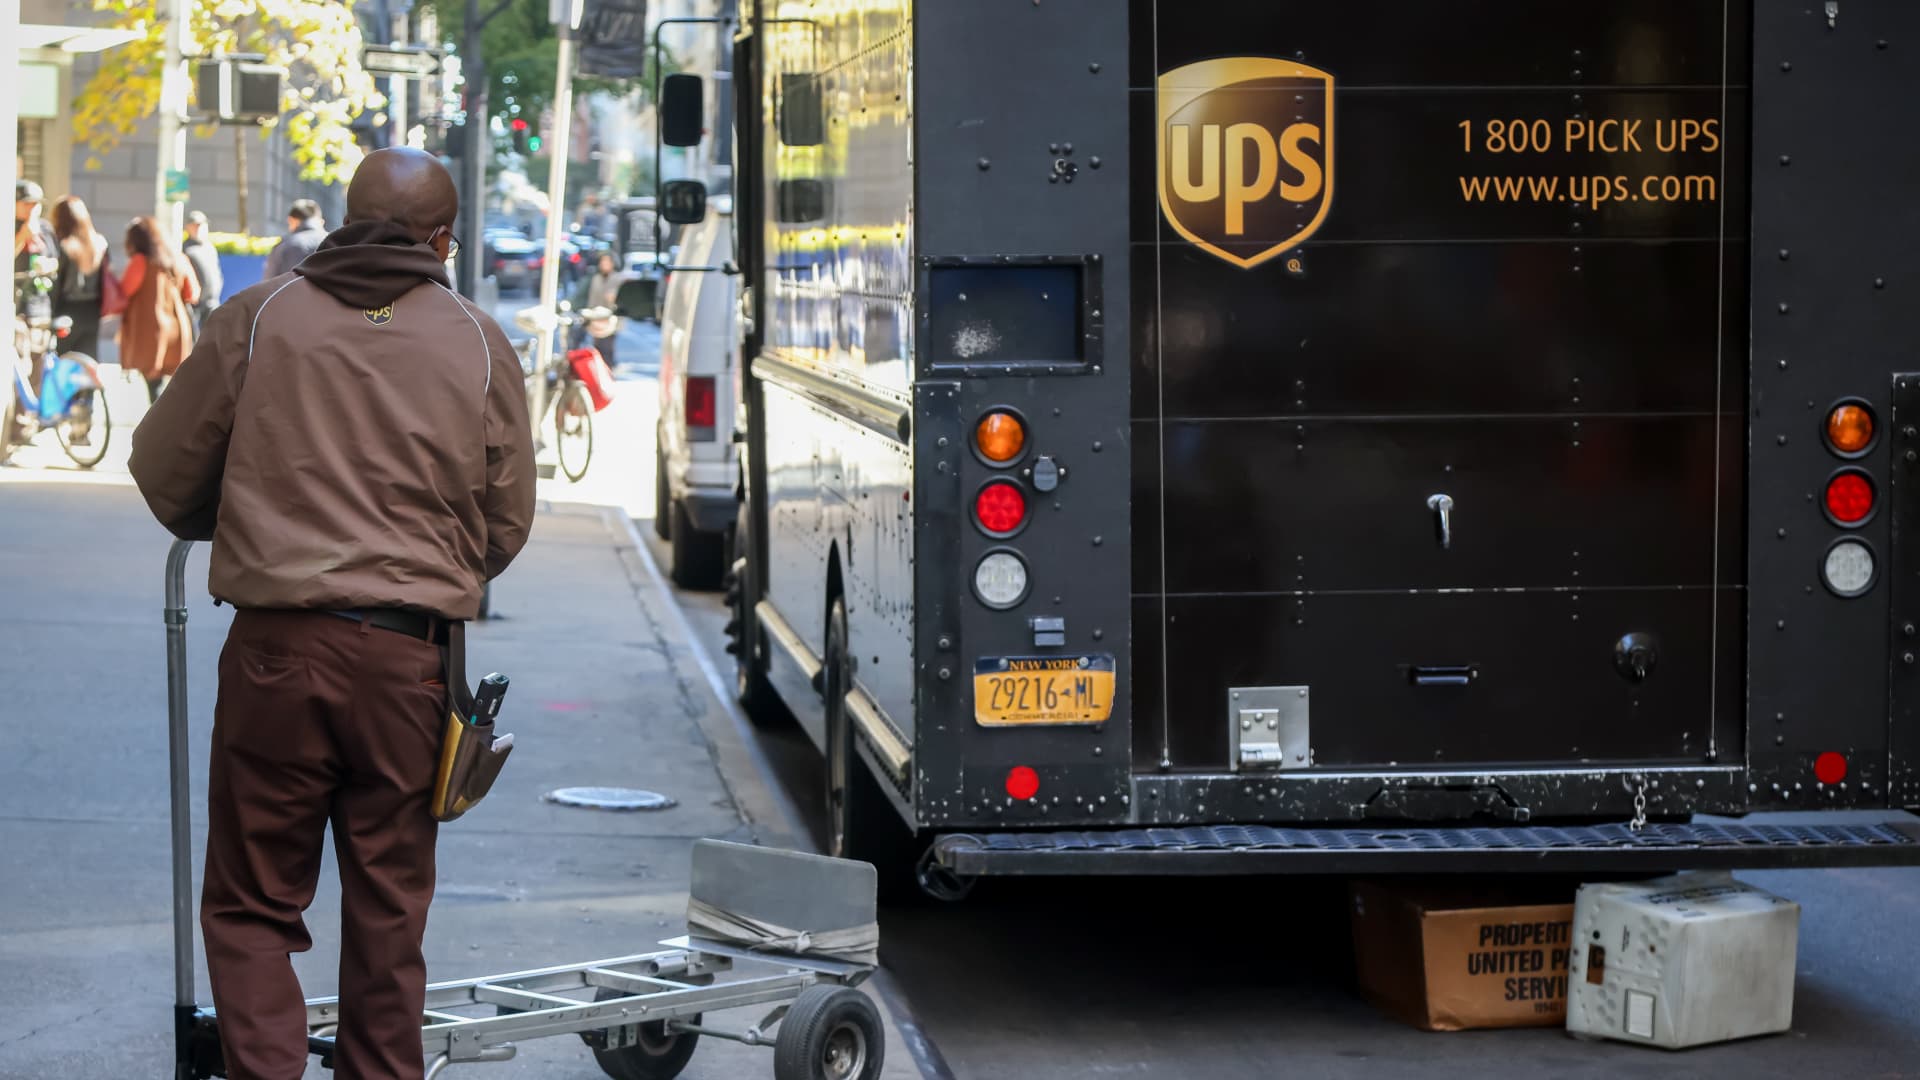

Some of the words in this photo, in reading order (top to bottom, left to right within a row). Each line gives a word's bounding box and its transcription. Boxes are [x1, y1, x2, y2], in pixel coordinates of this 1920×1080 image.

[1458, 119, 1472, 153] 1
[1485, 119, 1551, 153] 800
[1565, 119, 1642, 153] PICK
[1655, 119, 1720, 153] UPS
[1171, 122, 1323, 235] ups
[1458, 174, 1716, 211] www.ups.com
[1009, 660, 1042, 671] NEW
[1045, 659, 1080, 670] YORK
[1479, 921, 1572, 947] PROPERT
[1468, 949, 1544, 976] UNITED
[1504, 975, 1568, 1002] SERVI
